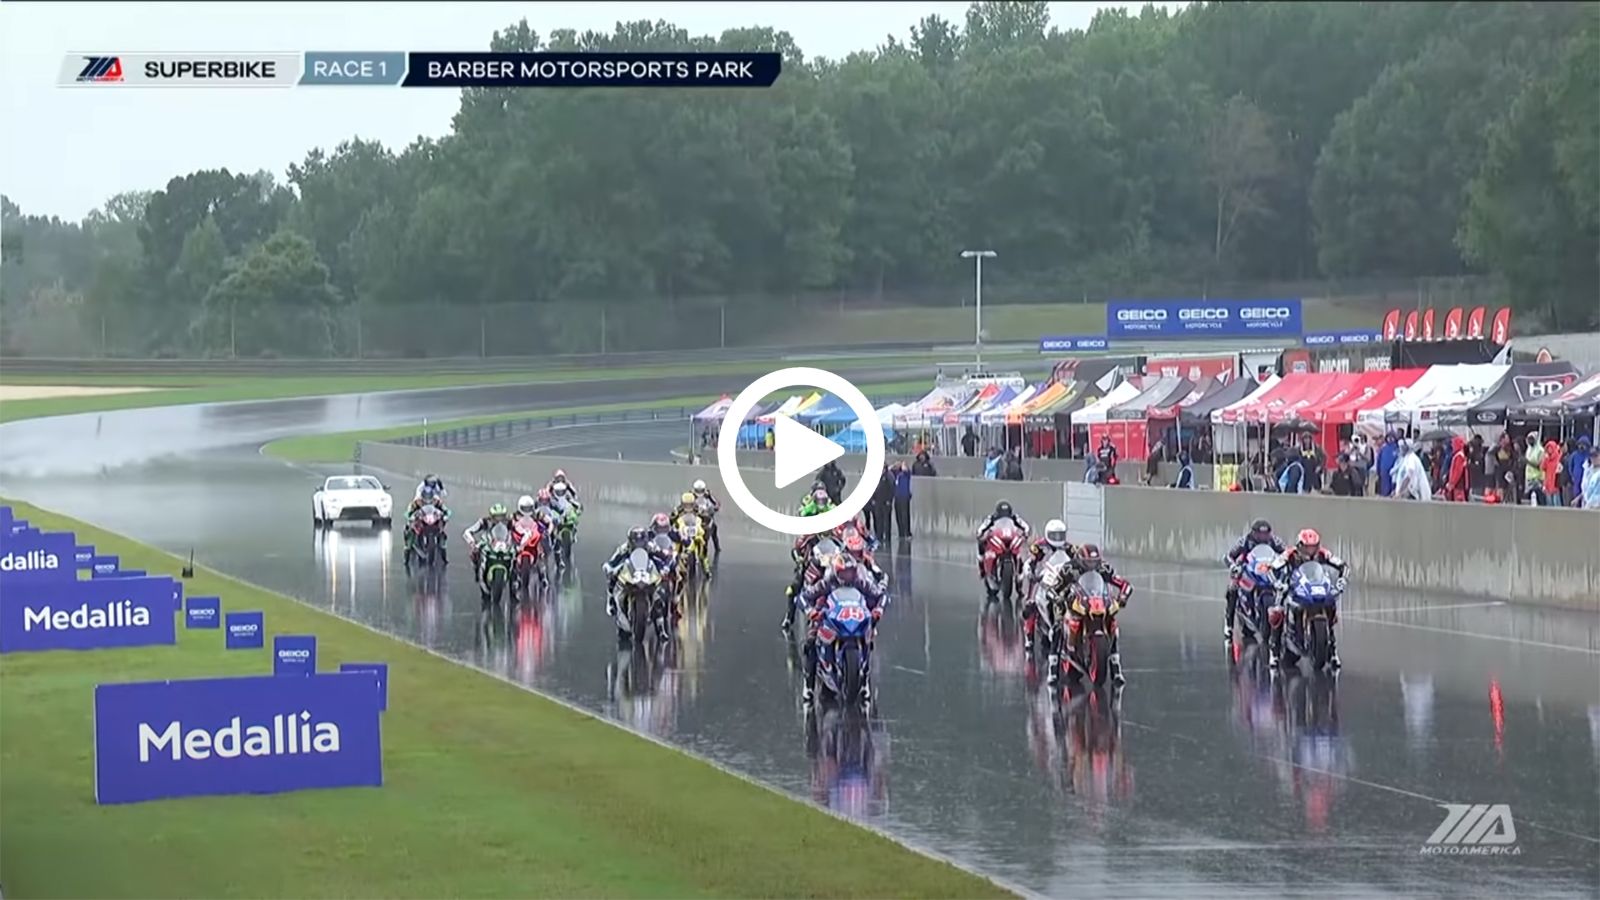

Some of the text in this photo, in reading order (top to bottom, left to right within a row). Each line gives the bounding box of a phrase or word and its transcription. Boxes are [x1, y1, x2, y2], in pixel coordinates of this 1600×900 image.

[1117, 307, 1290, 321] GEICO GEICO GEICO
[23, 600, 150, 632] Medallia
[138, 711, 341, 762] Medallia
